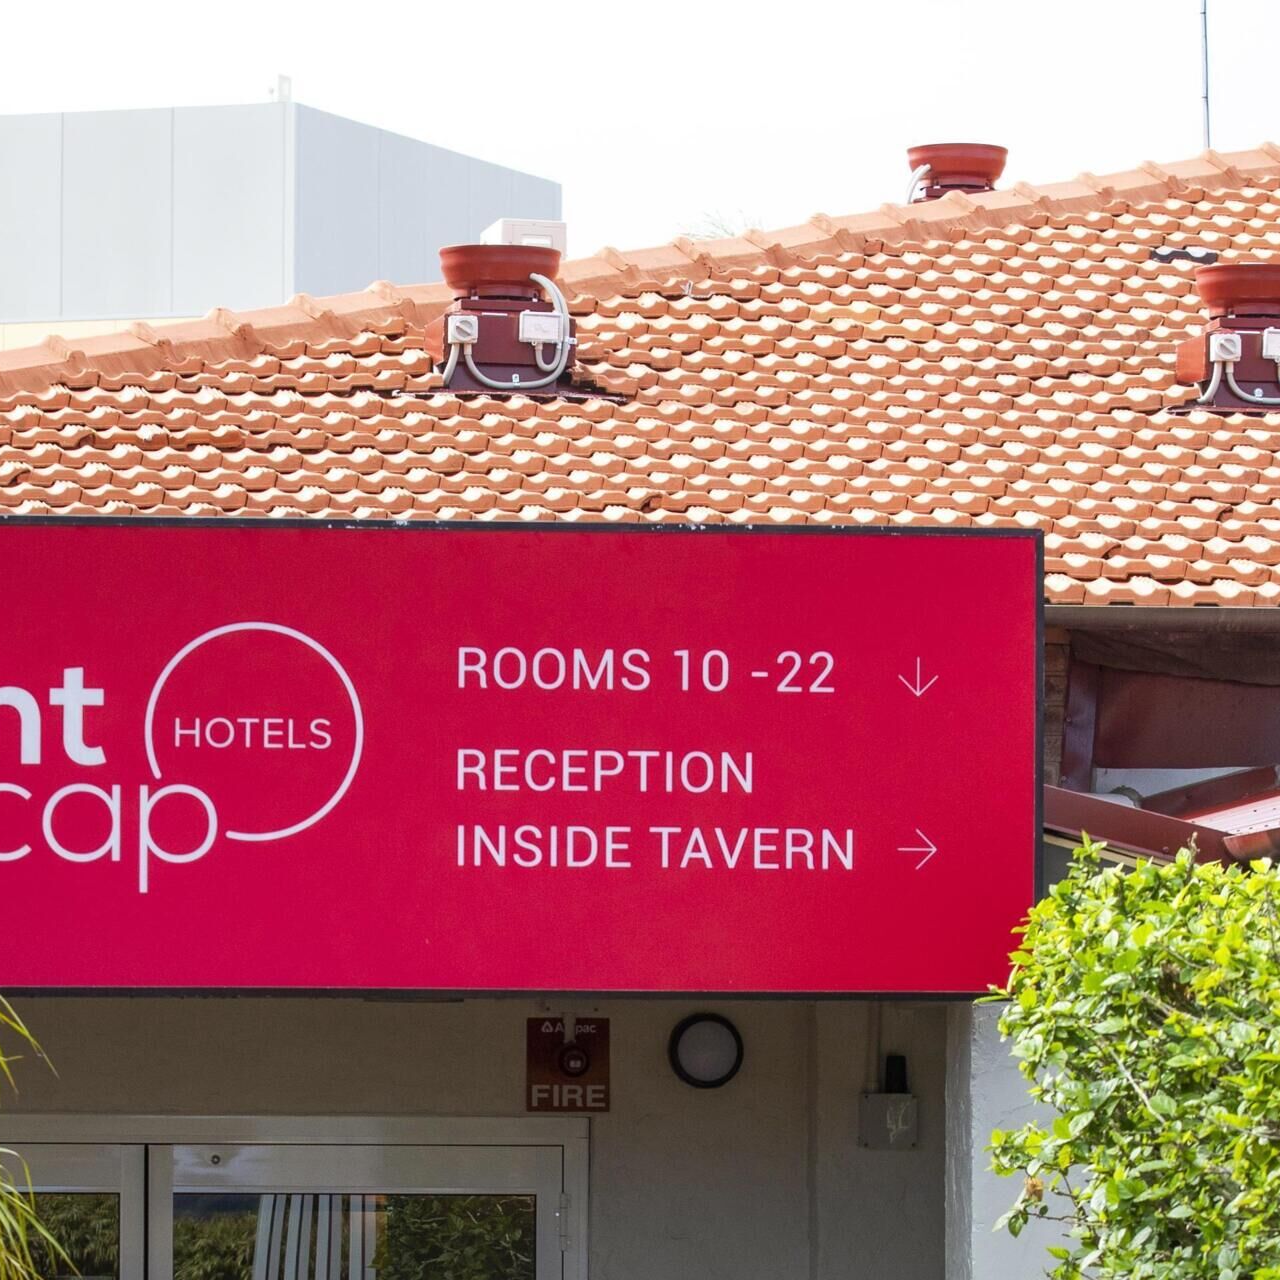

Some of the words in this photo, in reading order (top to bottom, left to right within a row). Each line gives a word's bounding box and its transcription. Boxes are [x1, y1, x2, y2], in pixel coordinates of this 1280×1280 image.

[457, 645, 652, 692] ROOMS
[673, 648, 730, 693] 10
[174, 716, 333, 750] HOTELS
[456, 747, 754, 794] RECEPTION
[456, 823, 632, 869] INSIDE
[648, 825, 854, 871] TAVERN
[554, 1021, 597, 1035] Apac
[530, 1083, 607, 1108] FIRE
